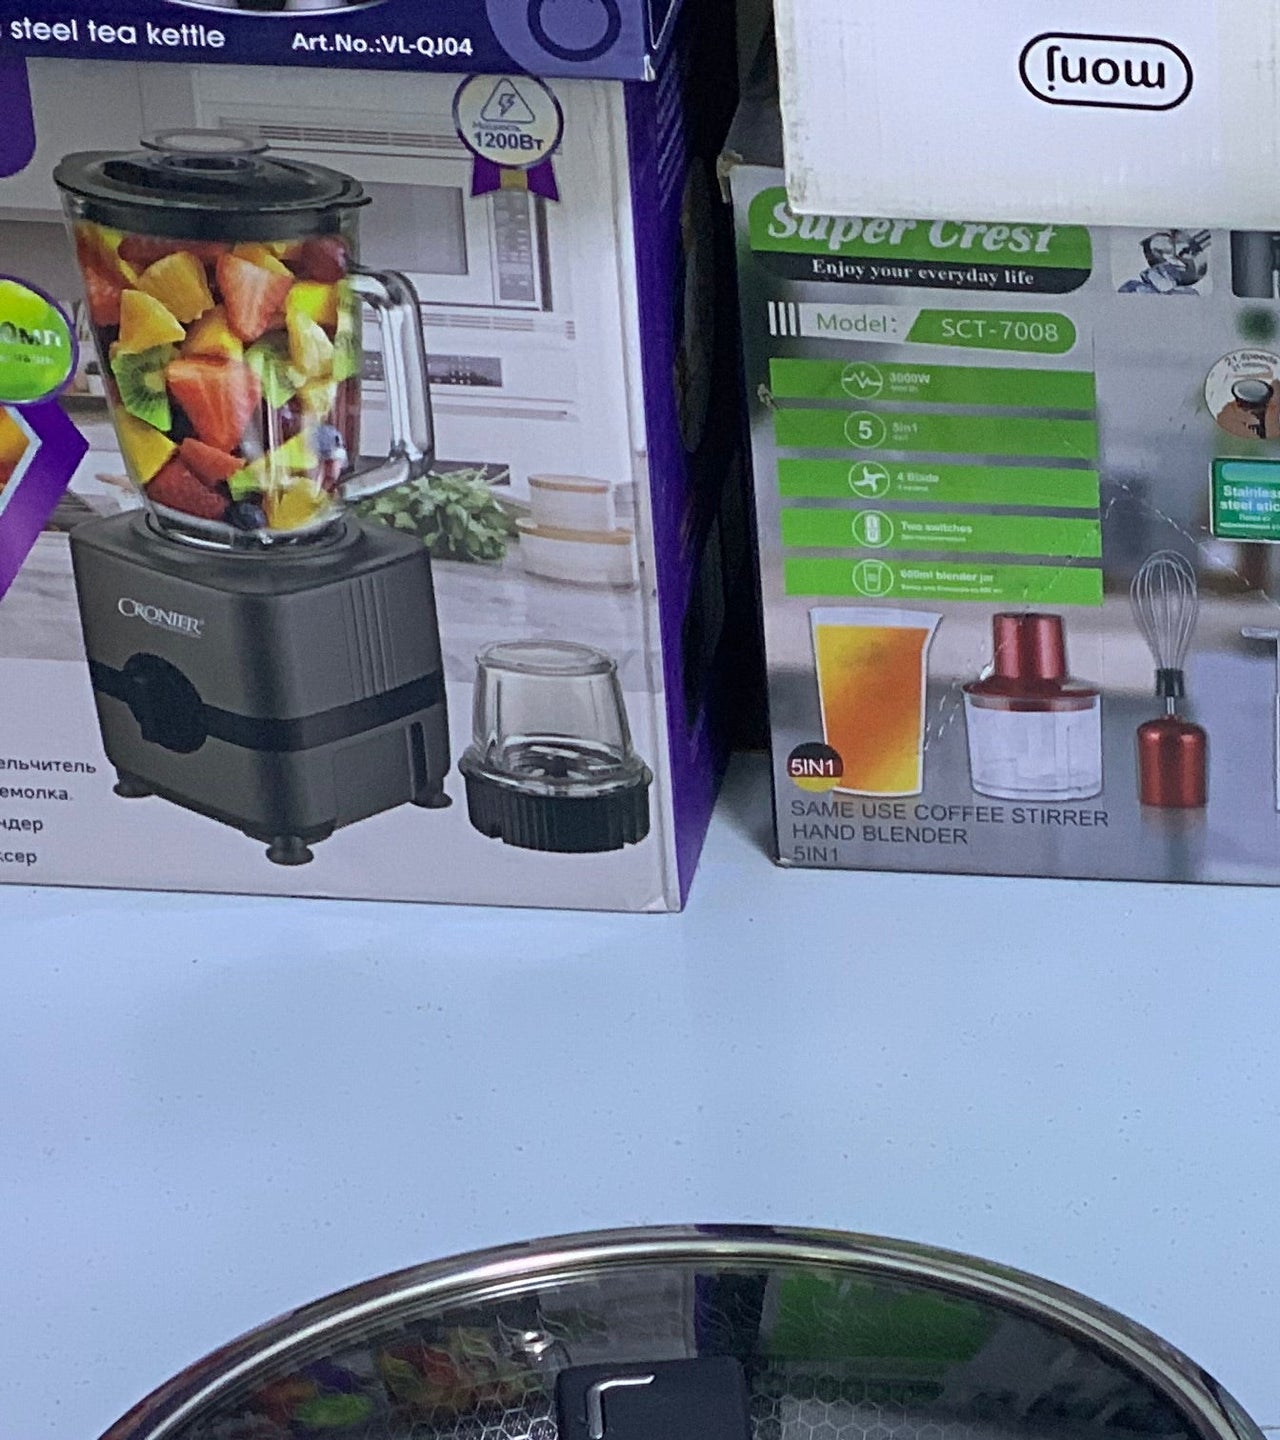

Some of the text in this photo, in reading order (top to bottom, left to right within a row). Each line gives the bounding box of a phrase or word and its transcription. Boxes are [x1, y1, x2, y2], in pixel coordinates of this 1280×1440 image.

[11, 17, 225, 48] steel tea kettle
[292, 32, 473, 58] Art.No.:VL-QJ04
[768, 201, 1056, 252] Super Crest
[812, 259, 1034, 288] Enjoy your everyday life
[817, 313, 1059, 342] Model: SCT-7008
[791, 758, 835, 776] 5IN1
[791, 801, 1109, 827] SAME USE COFFEE STIRRER
[792, 825, 968, 845] HAND BLENDER
[793, 846, 838, 862] 5IN1
